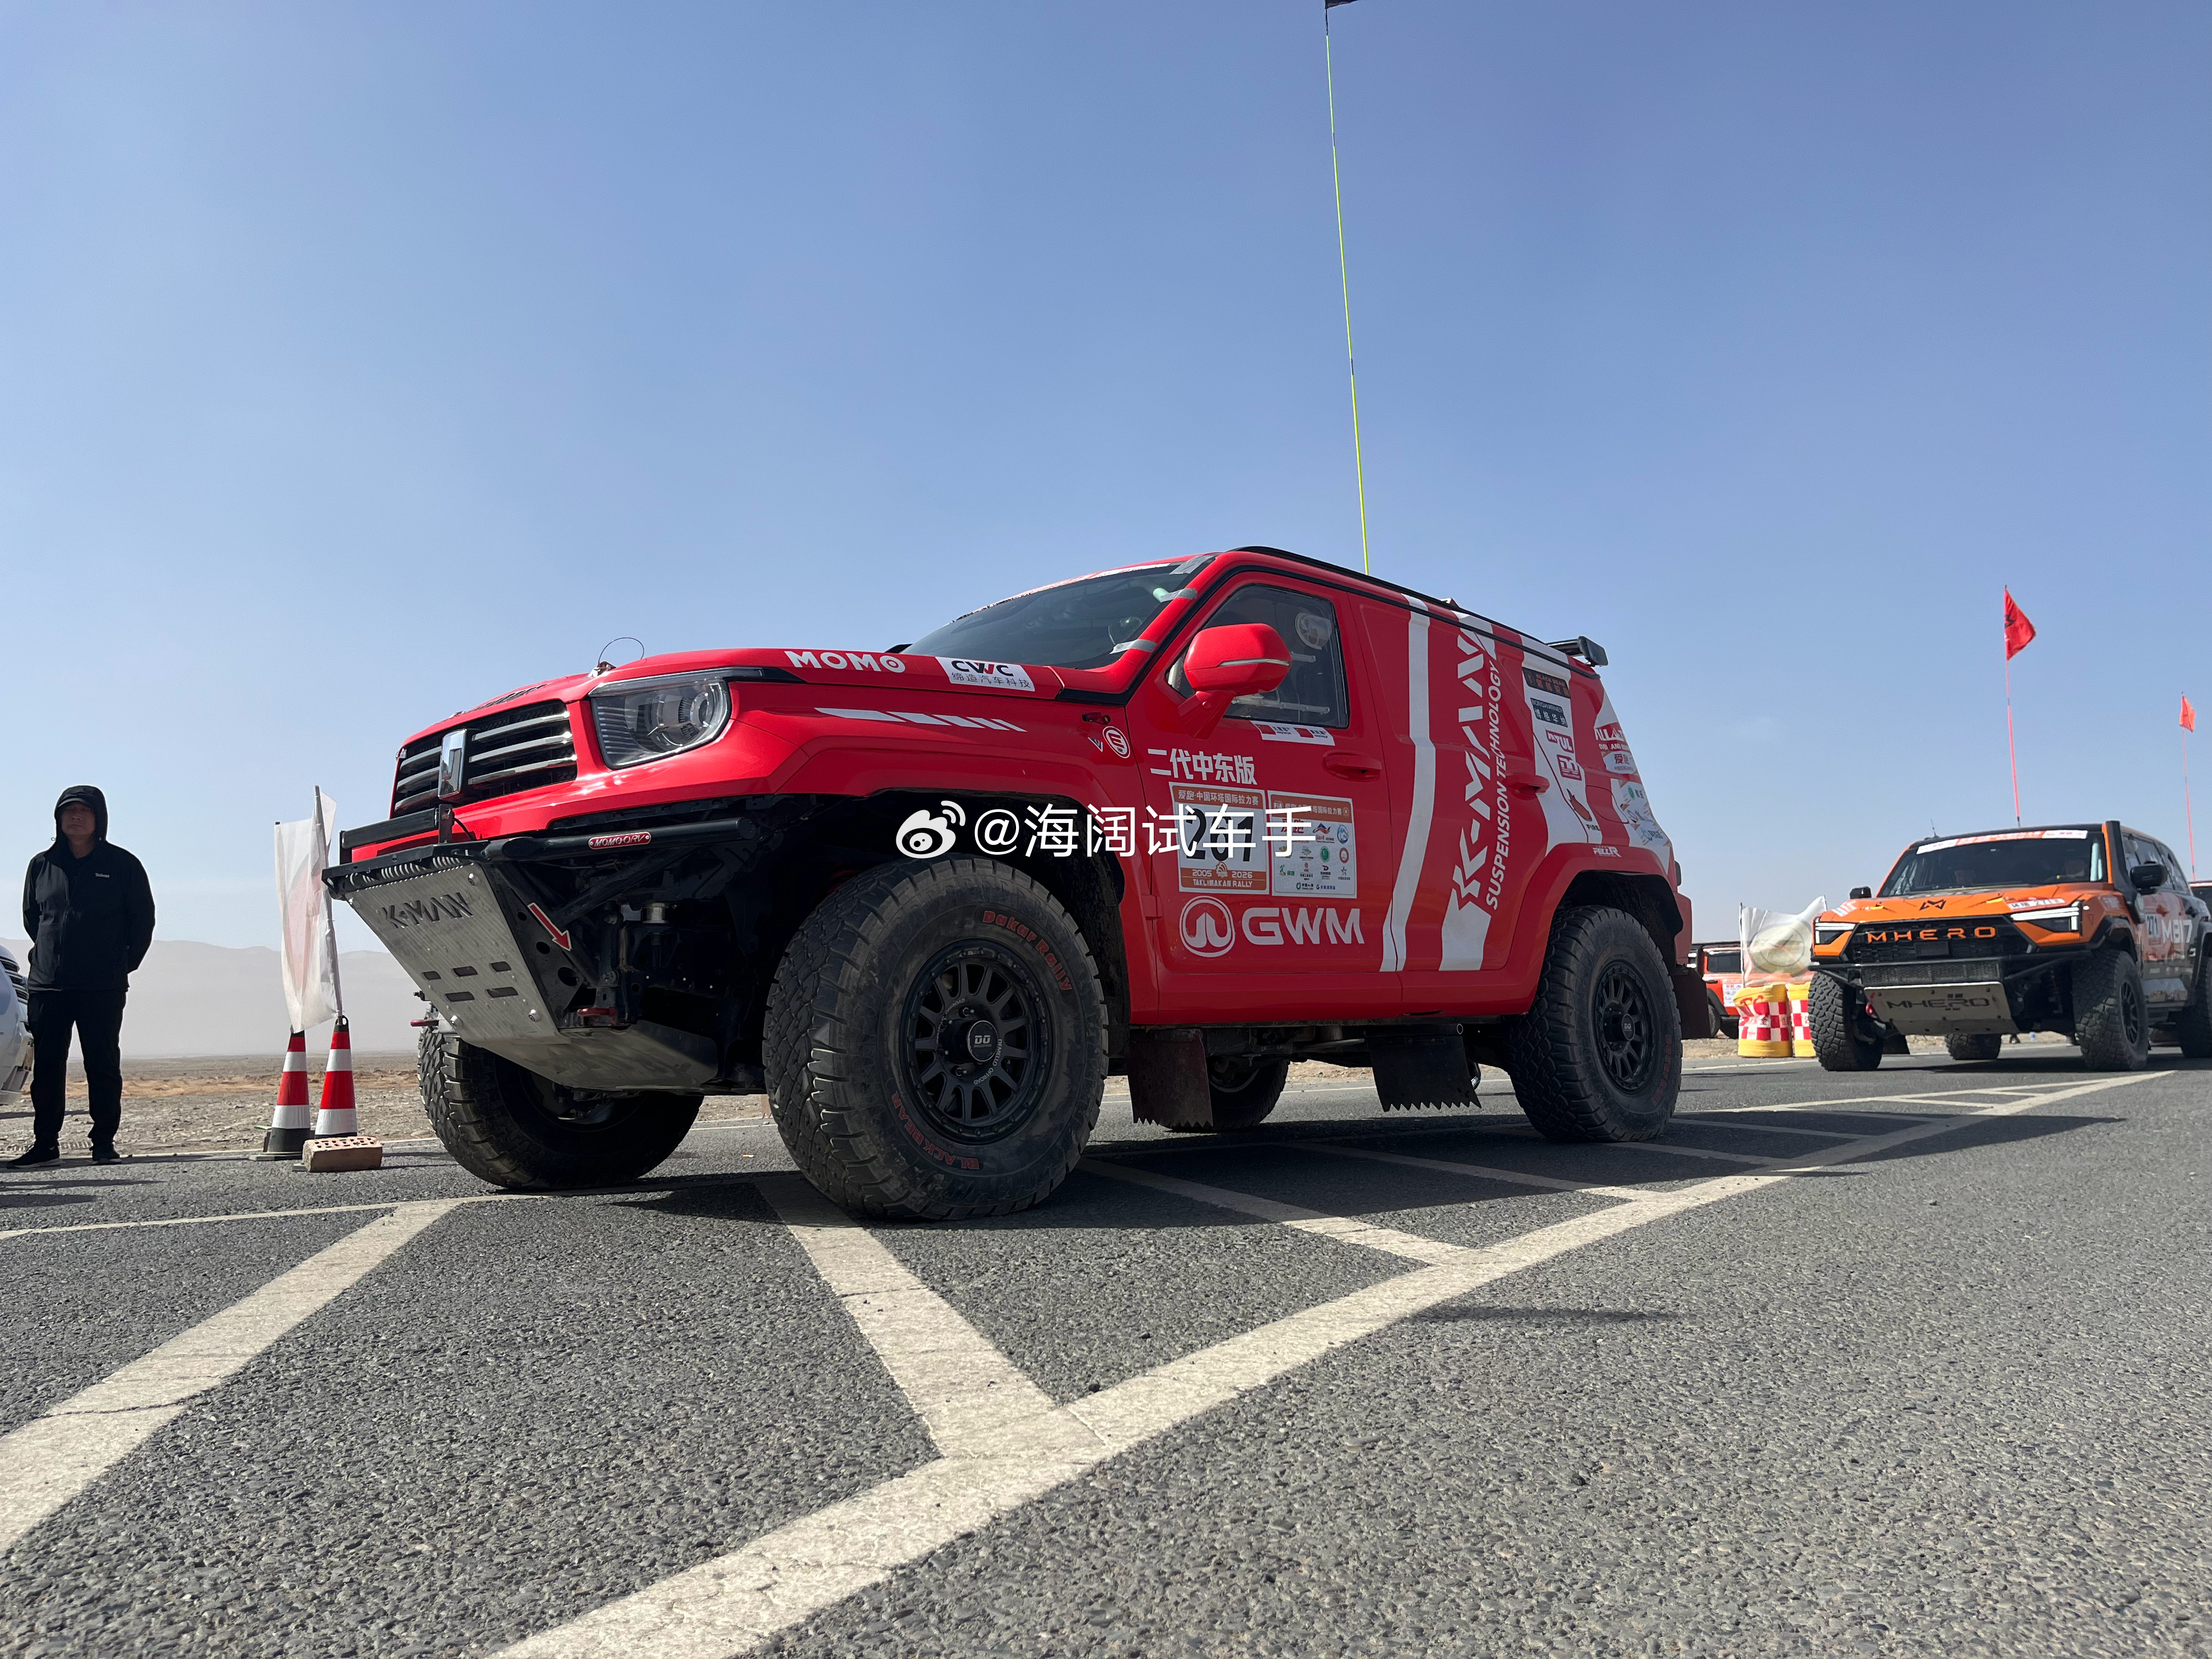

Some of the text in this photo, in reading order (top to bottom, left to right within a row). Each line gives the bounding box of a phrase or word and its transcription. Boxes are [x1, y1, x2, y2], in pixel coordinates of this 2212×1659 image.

[785, 651, 906, 673] MOMO
[951, 660, 1014, 676] CWC
[1147, 748, 1257, 785] 二代中东版
[1486, 660, 1509, 910] SUSPENSION TECHNOLOGY
[1193, 879, 1231, 887] TAKLIMAKAN
[382, 892, 473, 929] K-MAN
[1242, 907, 1365, 945] GWM
[981, 910, 1073, 991] Dakar Rally
[1867, 926, 1997, 945] MHERO
[973, 1039, 1003, 1085] DEMELLO OFFROAD
